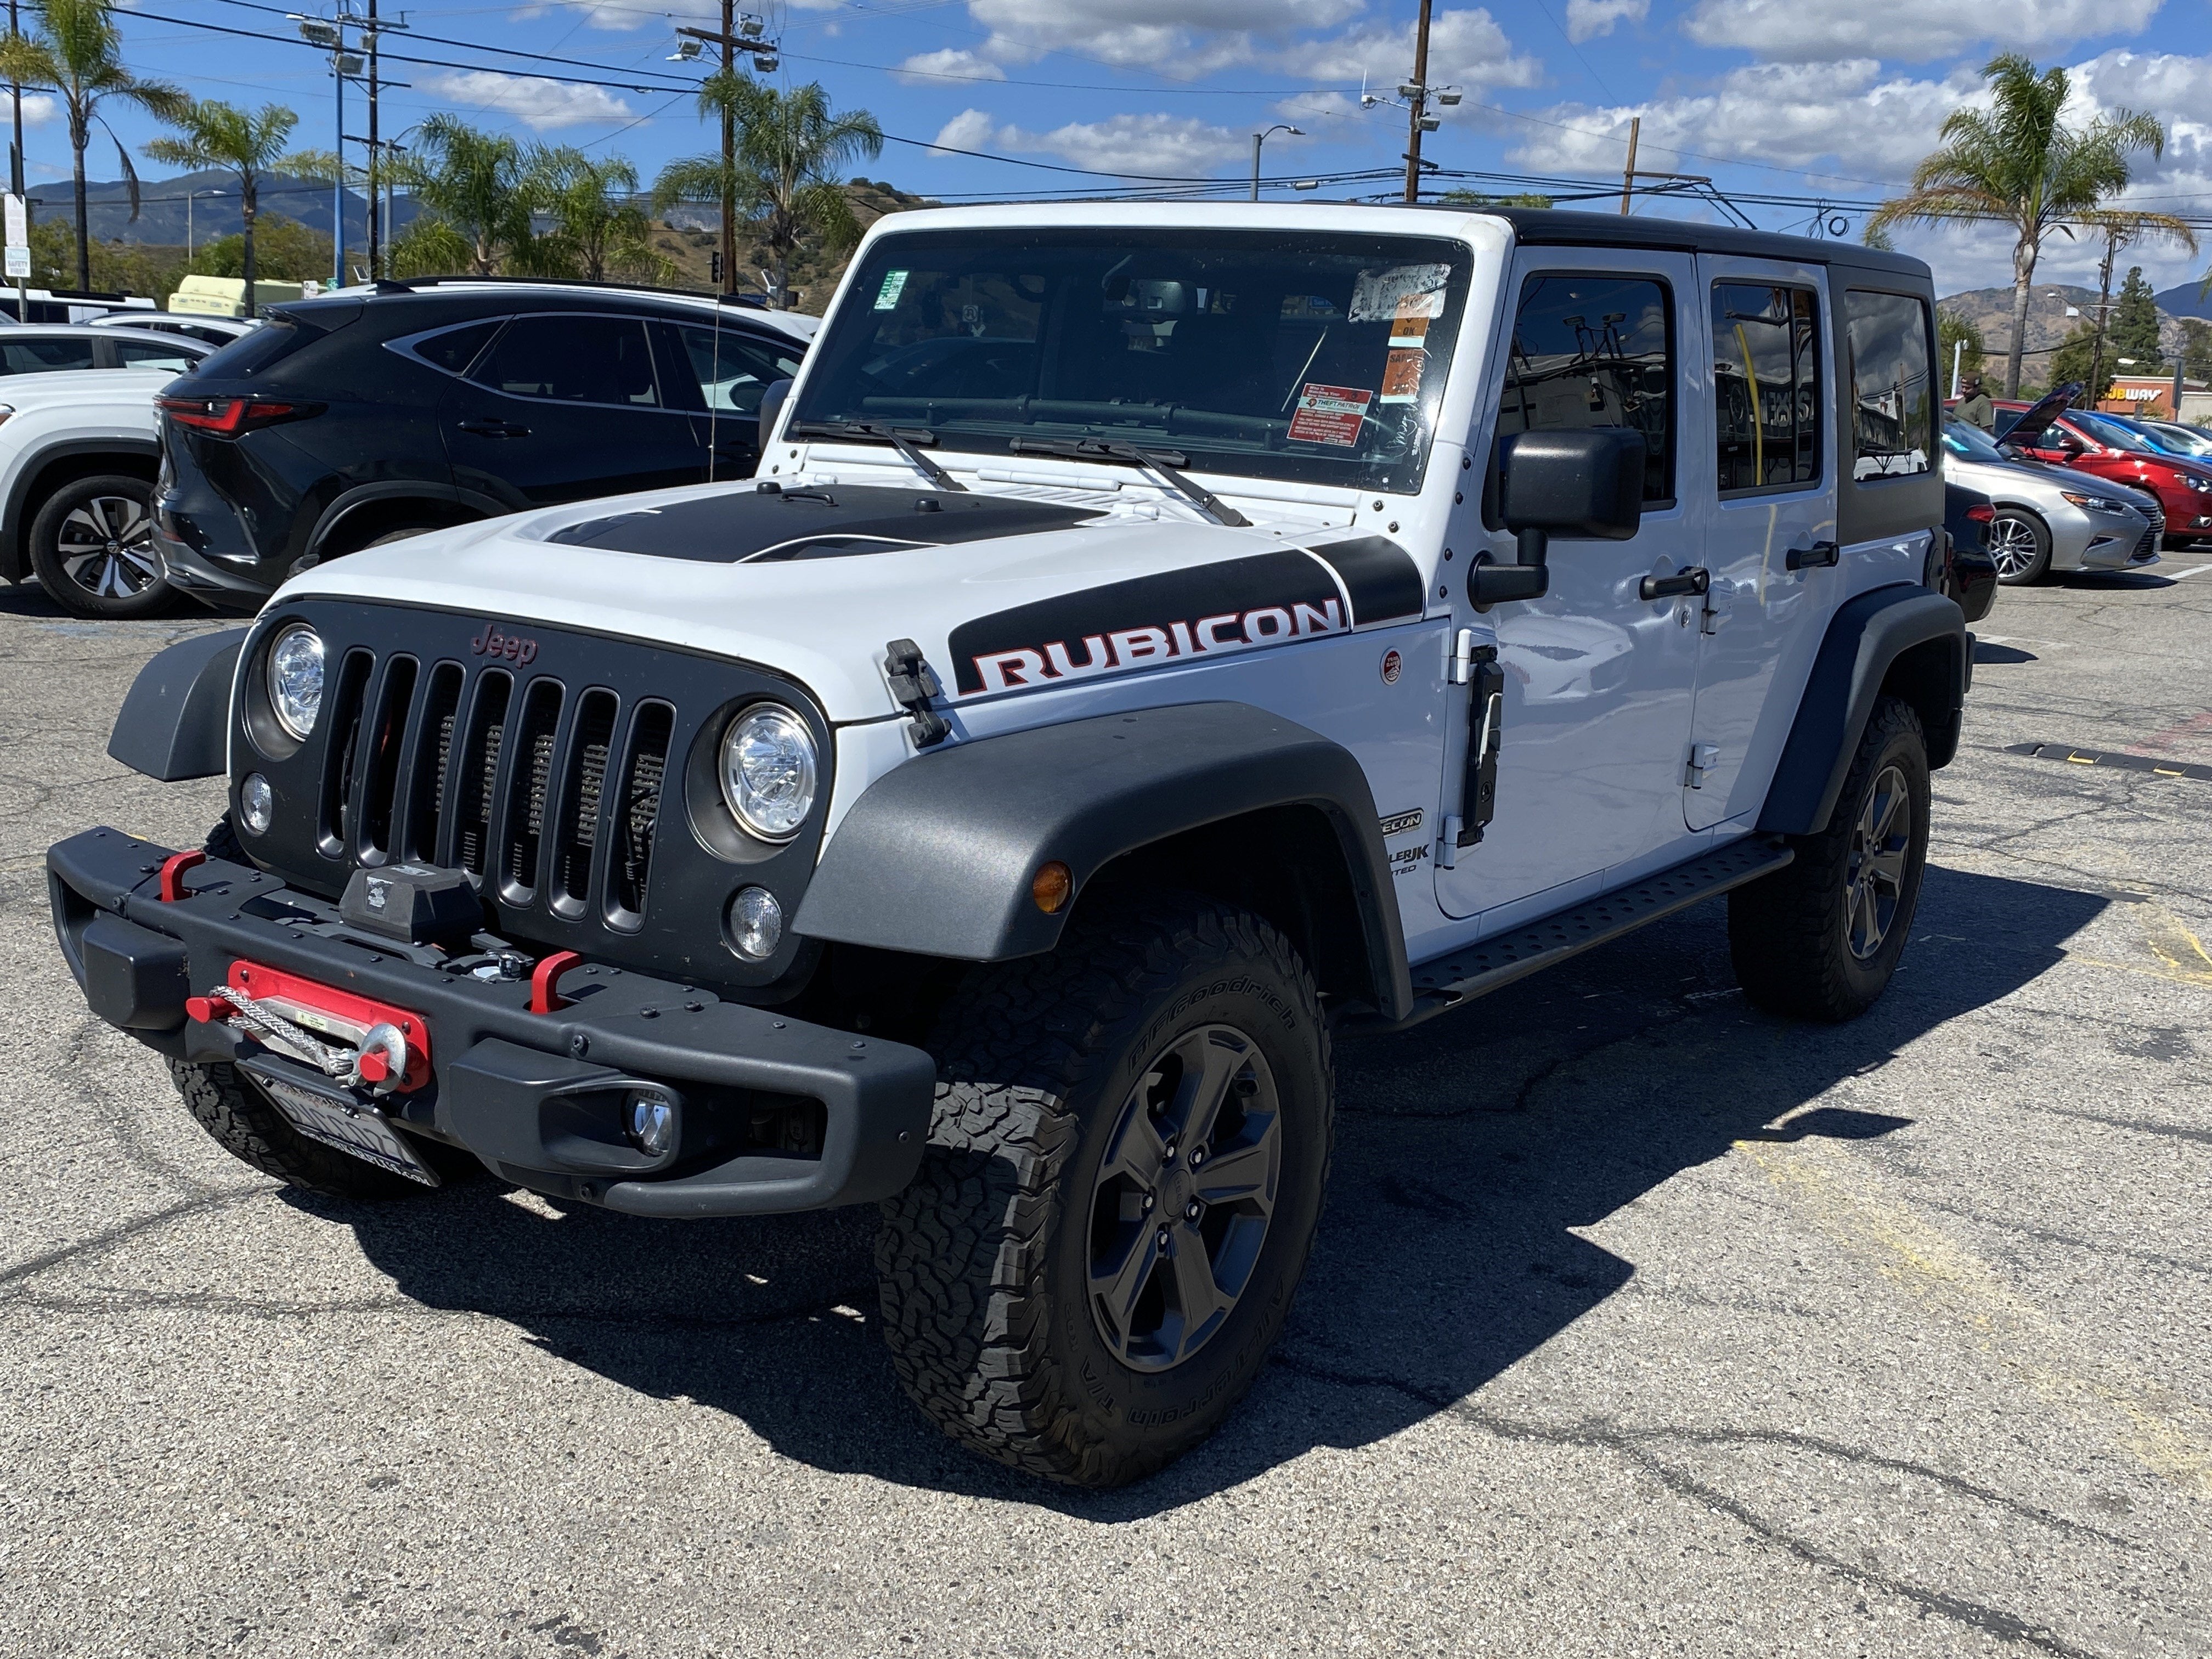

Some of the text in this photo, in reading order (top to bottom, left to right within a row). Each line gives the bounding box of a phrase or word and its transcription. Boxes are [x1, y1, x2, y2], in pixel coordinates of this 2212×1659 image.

[1402, 327, 1416, 336] OK
[471, 624, 539, 669] Jeep
[972, 597, 1348, 692] RUBICON
[1381, 814, 1421, 833] ECON
